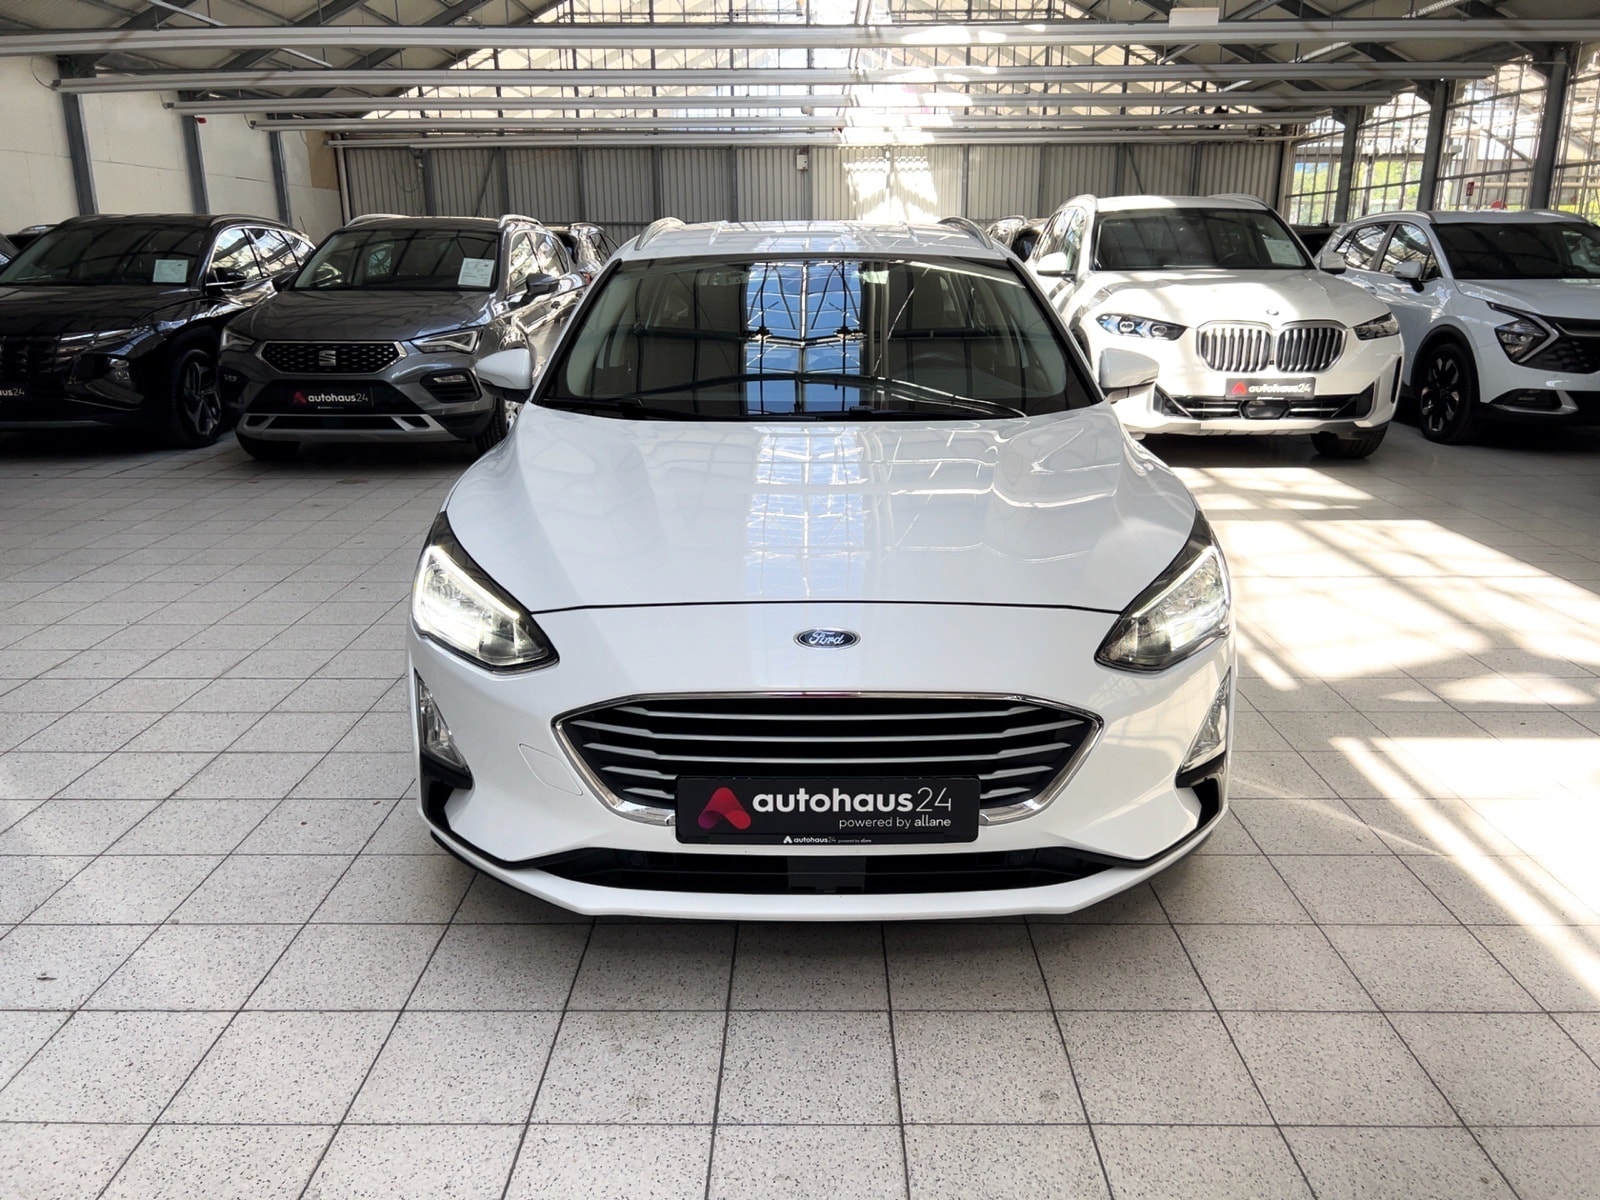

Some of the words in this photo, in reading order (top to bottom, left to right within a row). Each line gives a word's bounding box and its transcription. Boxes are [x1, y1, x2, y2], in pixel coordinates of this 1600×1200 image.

[307, 393, 369, 403] autohaus24
[808, 629, 845, 645] Ford
[752, 787, 952, 813] autohaus24
[839, 816, 893, 830] powered
[896, 816, 912, 830] by
[914, 816, 952, 828] allane
